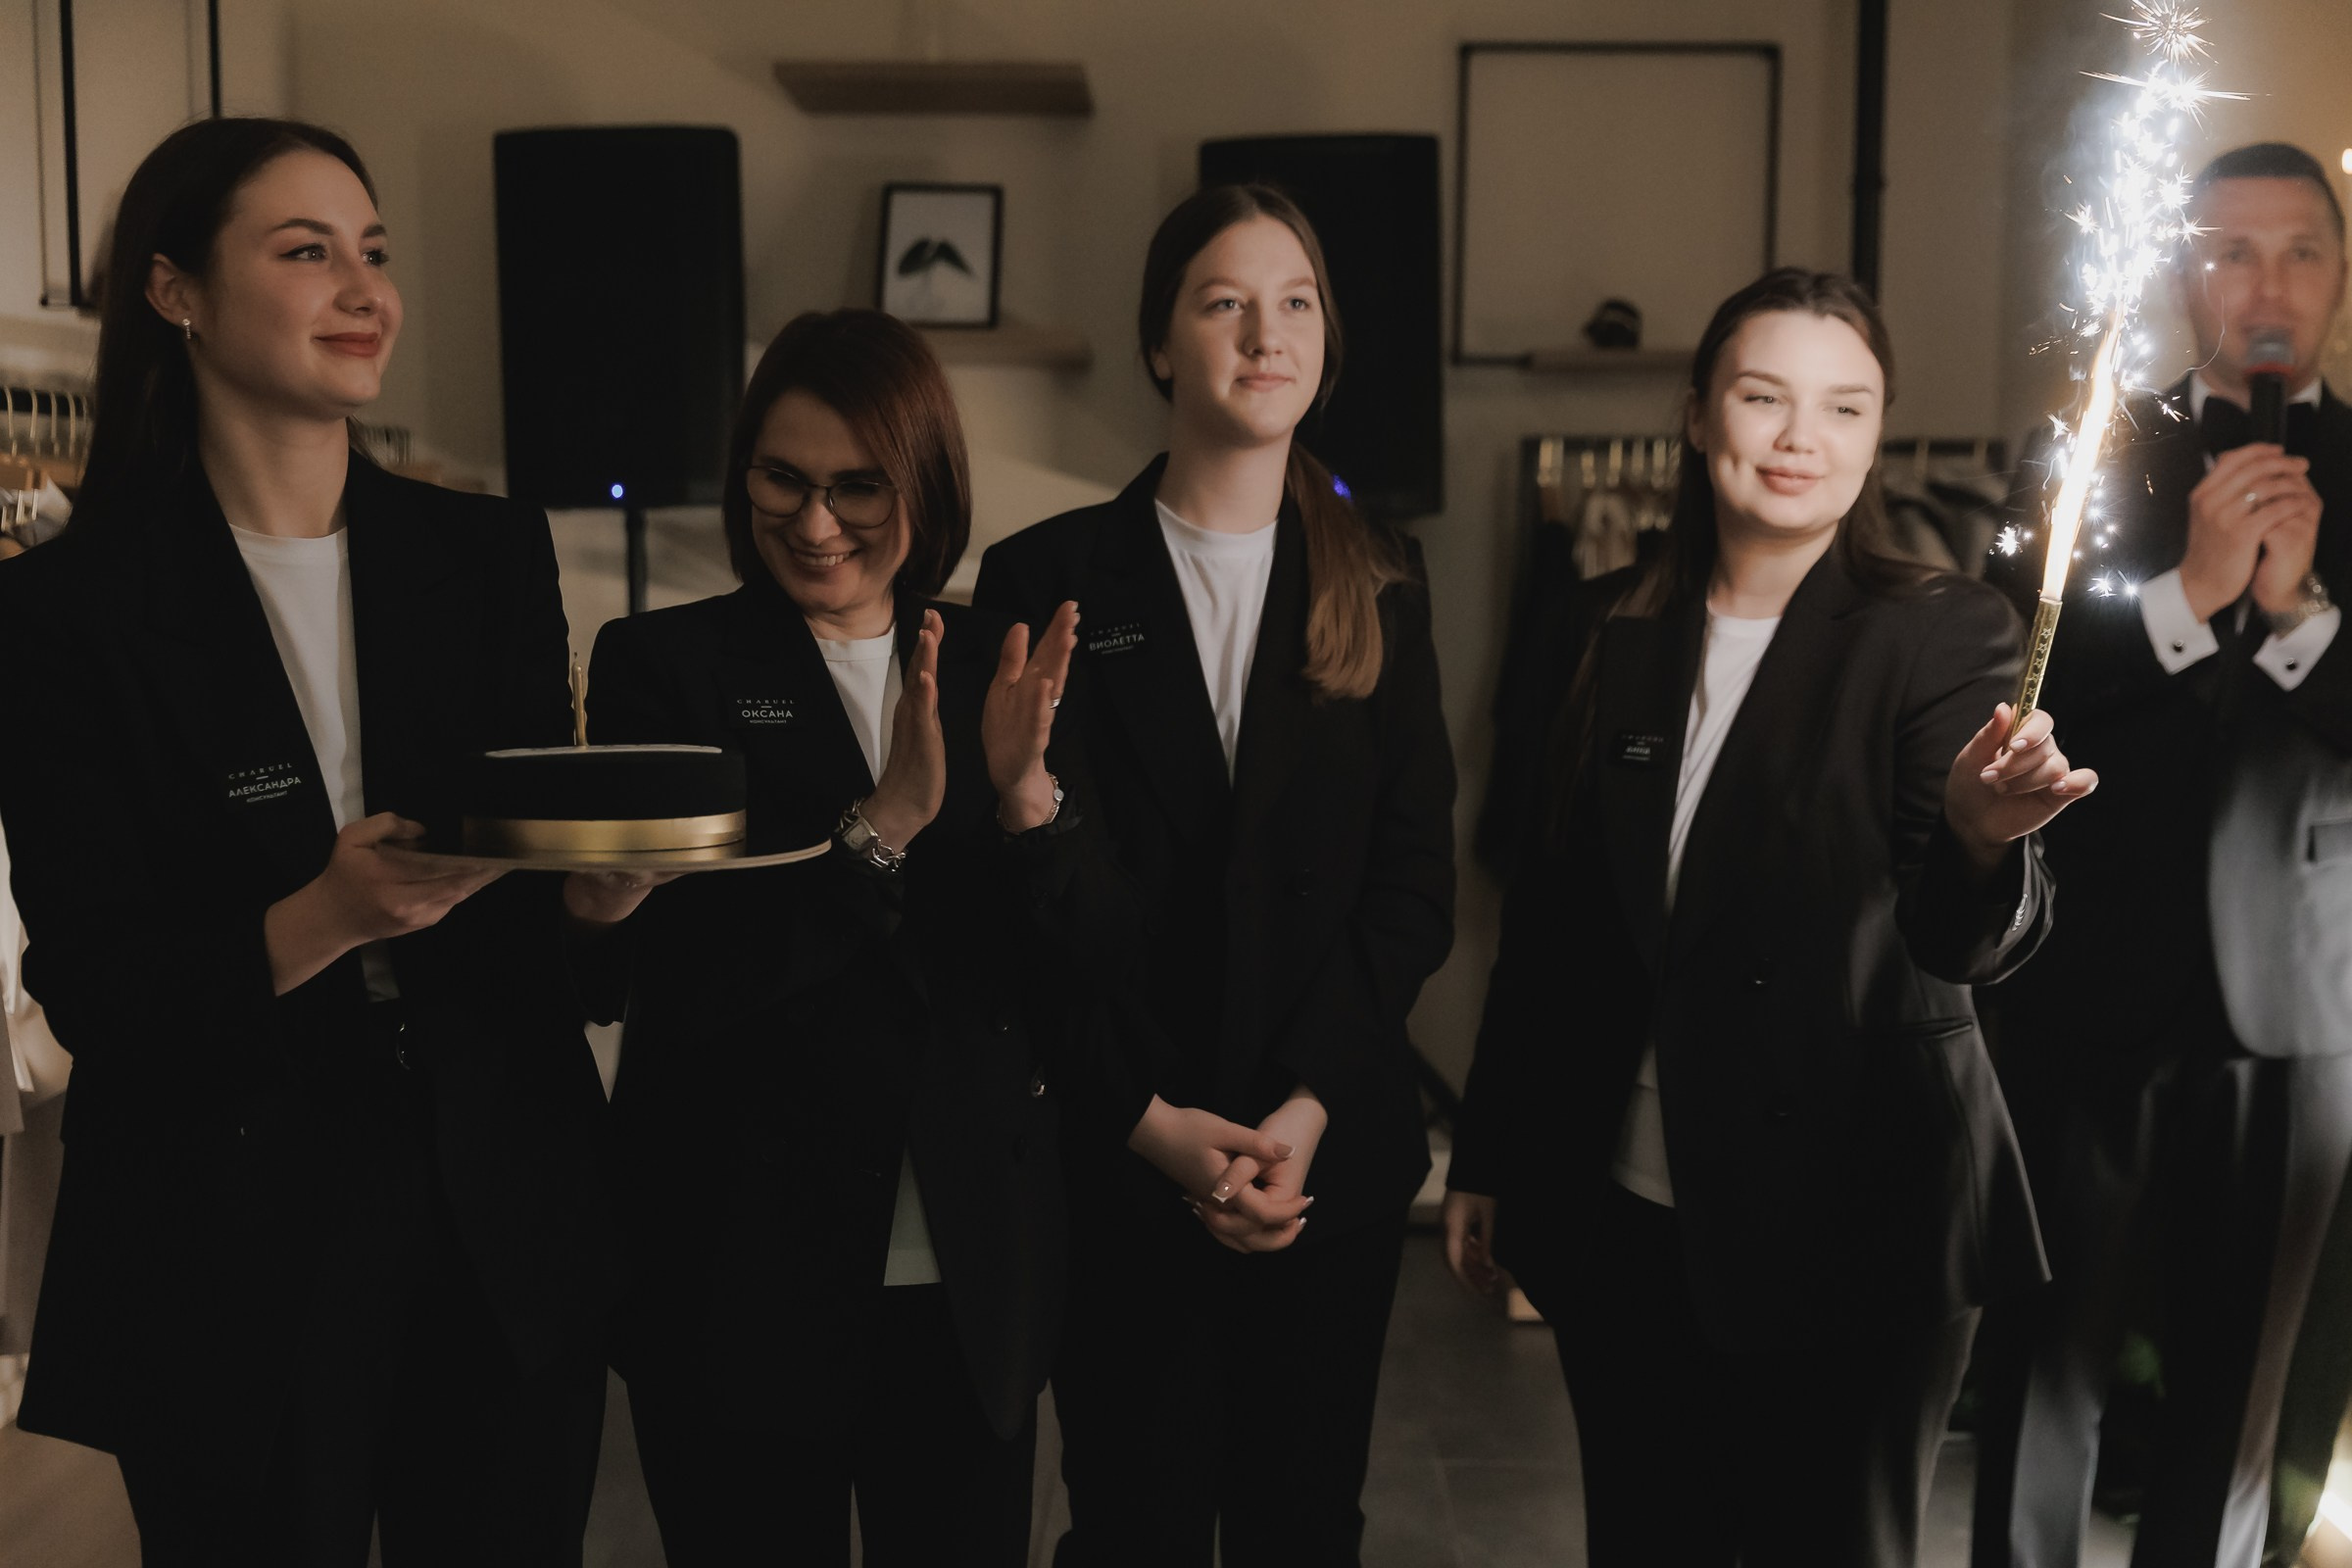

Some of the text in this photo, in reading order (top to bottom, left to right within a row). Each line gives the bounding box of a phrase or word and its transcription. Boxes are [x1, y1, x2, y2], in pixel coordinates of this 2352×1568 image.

[1089, 633, 1146, 652] ВИОЛЕТТА
[742, 710, 794, 718] ОКСАНА
[228, 762, 292, 780] CHARUEL
[228, 776, 302, 799] АЛЕКСАНДРА
